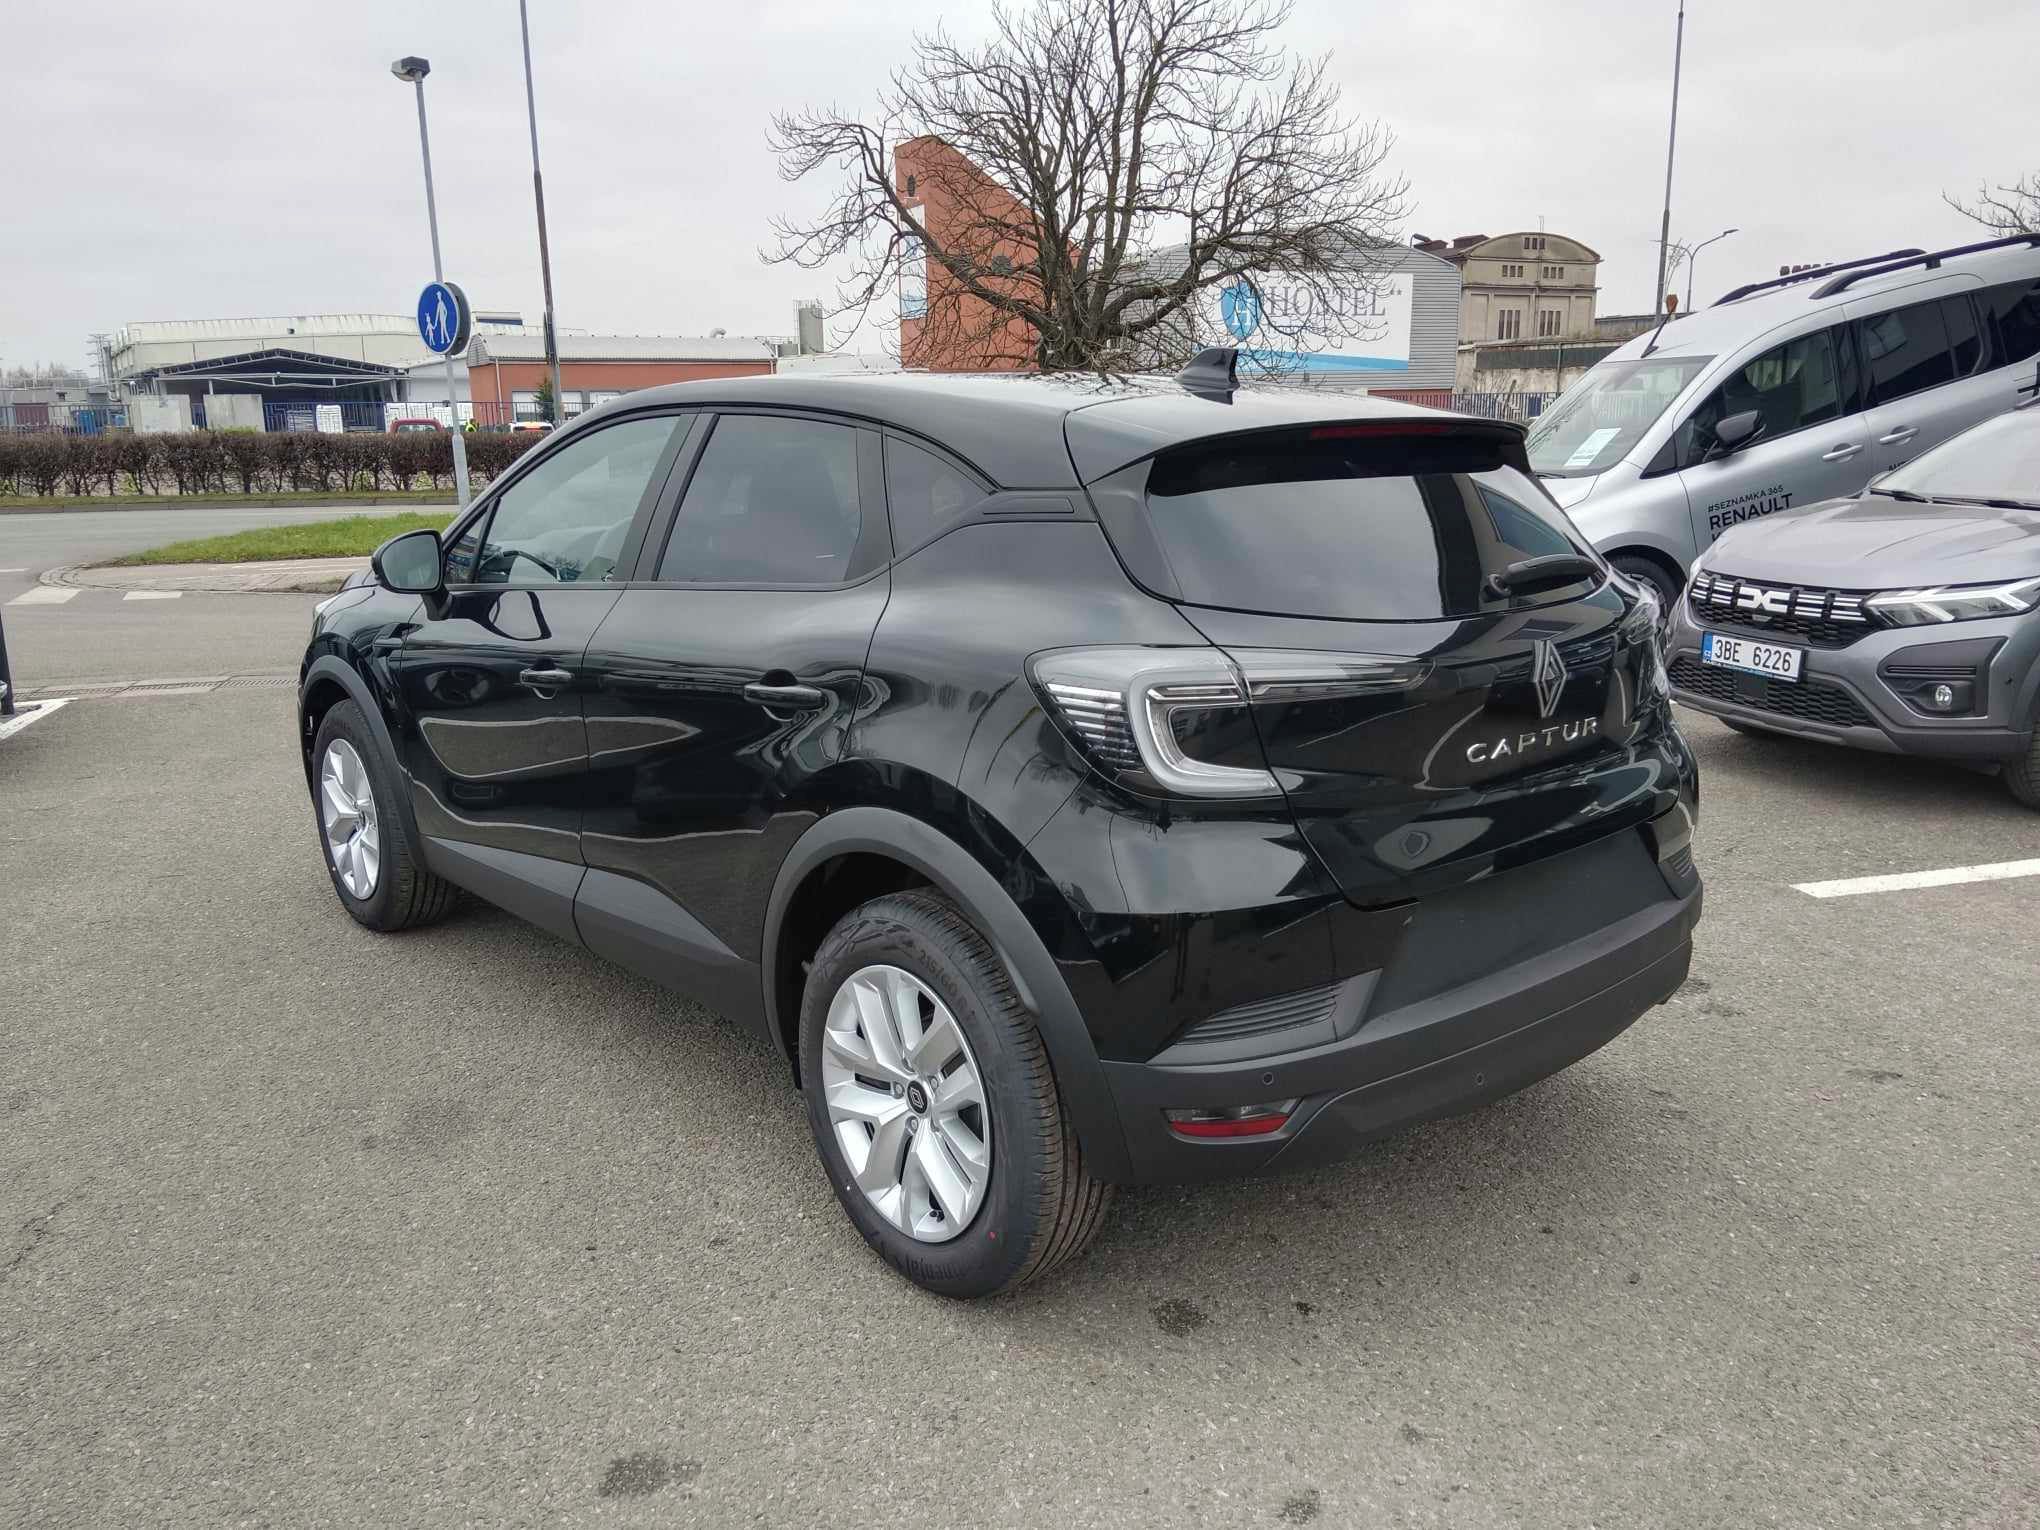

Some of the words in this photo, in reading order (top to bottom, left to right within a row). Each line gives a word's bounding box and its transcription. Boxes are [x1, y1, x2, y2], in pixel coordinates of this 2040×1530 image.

[1268, 286, 1386, 317] HOSTEL
[1708, 489, 1766, 512] #SEZNAMKA
[1767, 484, 1784, 496] 365
[1709, 493, 1793, 530] RENAULT
[1714, 639, 1742, 663] 3BE
[1752, 646, 1793, 672] 6226
[1466, 717, 1598, 763] CAPTUR
